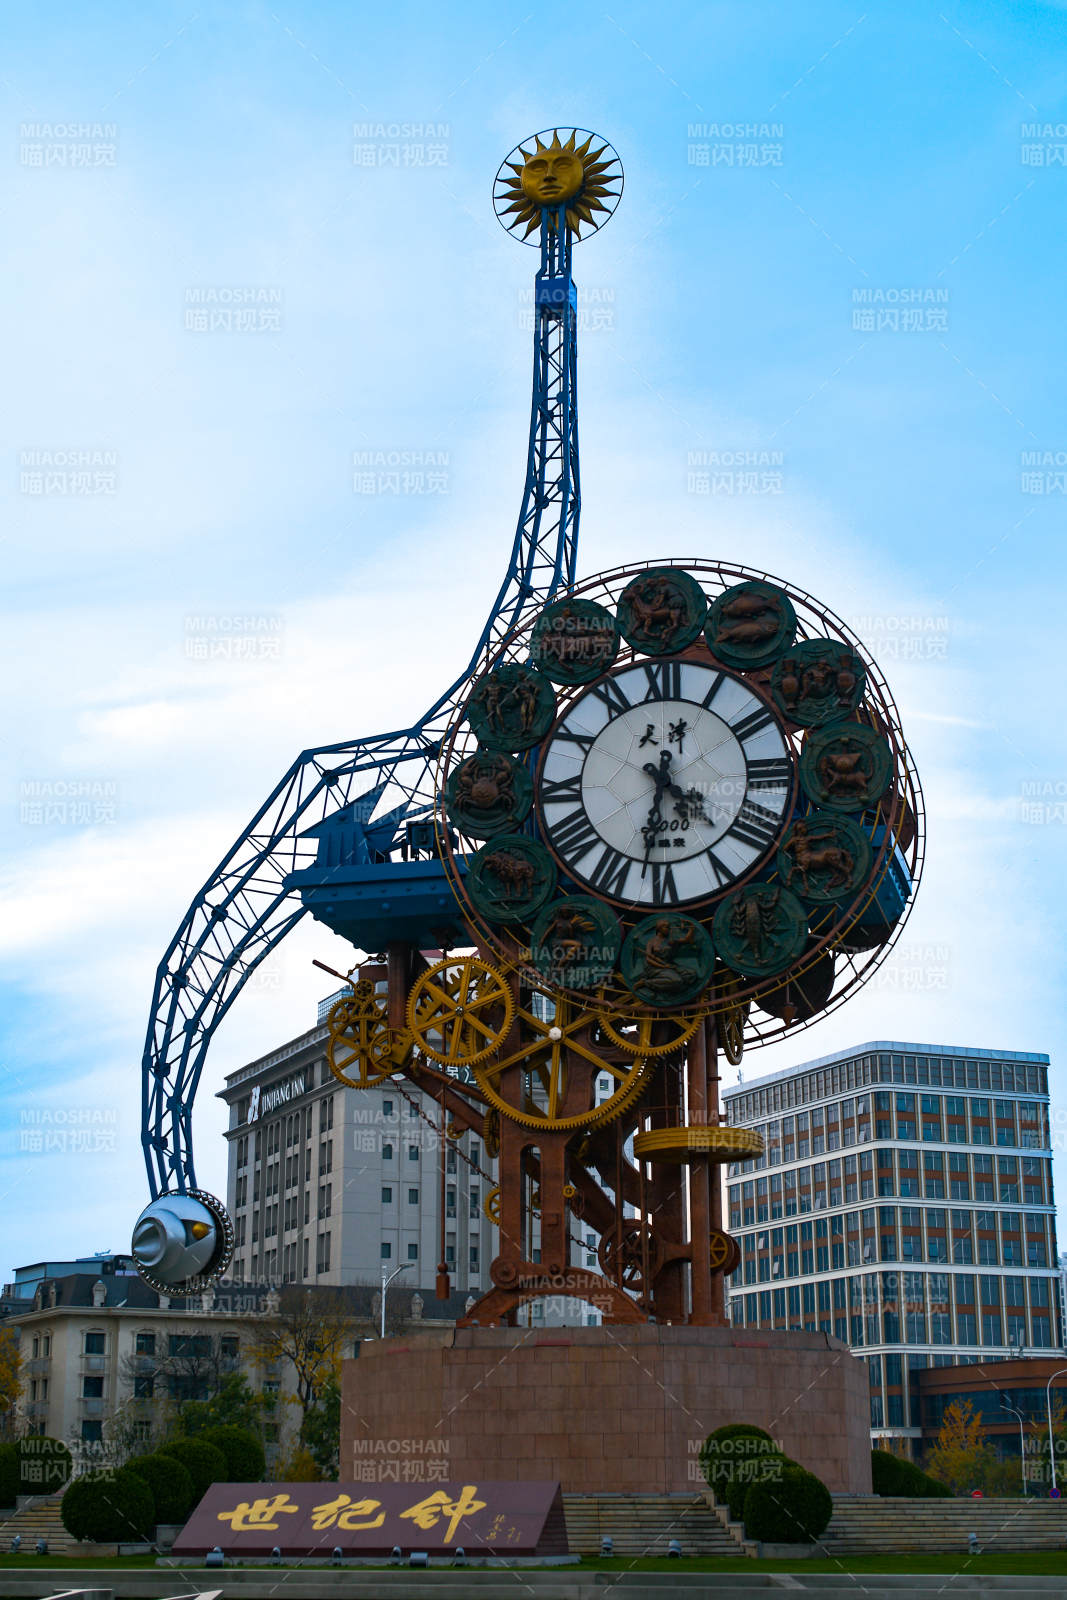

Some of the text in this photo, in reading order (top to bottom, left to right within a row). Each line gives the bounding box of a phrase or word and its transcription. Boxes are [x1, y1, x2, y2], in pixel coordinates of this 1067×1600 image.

[591, 676, 632, 720] XI
[643, 663, 681, 700] XII
[639, 717, 688, 754] 天津
[589, 846, 632, 898] VII
[261, 1075, 305, 1118] JINJIANG INN
[217, 1485, 487, 1544] 世纪钟
